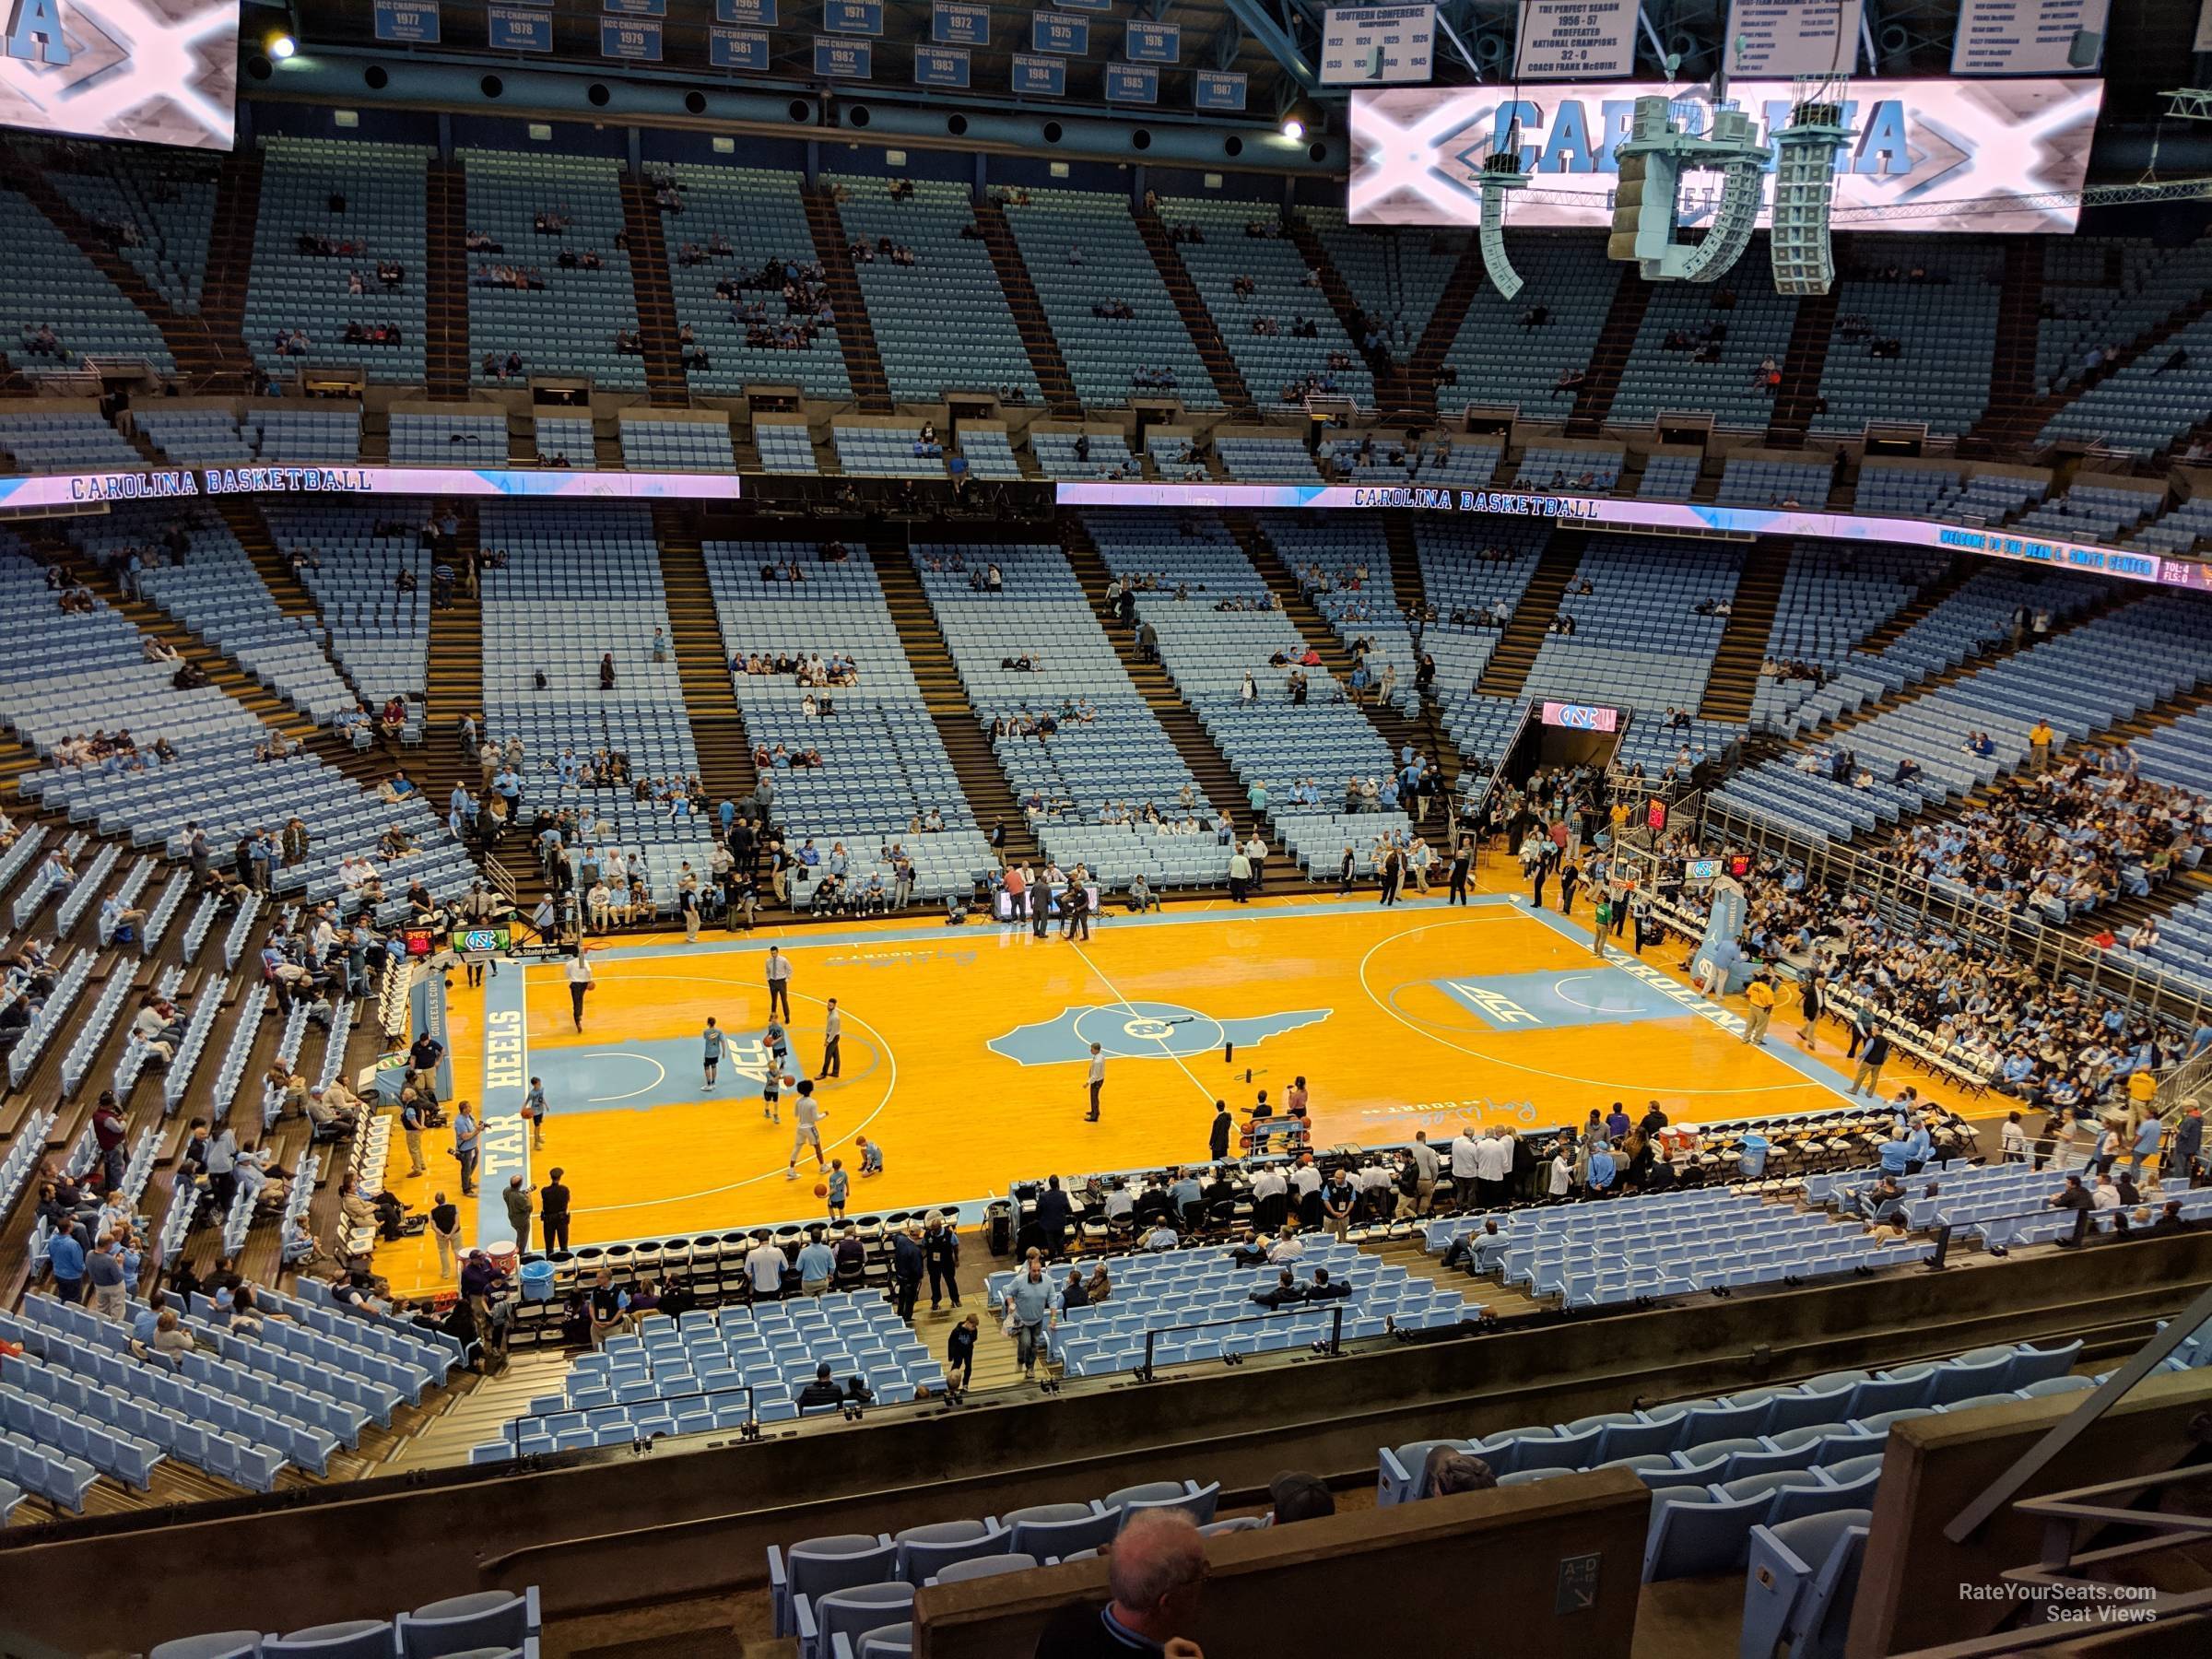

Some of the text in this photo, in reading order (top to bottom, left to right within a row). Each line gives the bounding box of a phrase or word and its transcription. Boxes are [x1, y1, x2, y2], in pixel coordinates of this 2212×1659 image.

[1335, 7, 1425, 21] SOUTHERN CONFERENCE
[1554, 5, 1587, 13] PERFECT
[1533, 38, 1618, 48] NATIONAL CHAMPIONS
[1552, 28, 1600, 37] UNDEFEATED
[1528, 63, 1554, 72] COACH
[1556, 63, 1581, 71] FRANK
[70, 467, 372, 500] CAROLINA BASKETBALL
[1354, 488, 1599, 519] CAROLINA BASKETBALL
[1940, 530, 1985, 548] WELCOME
[2005, 539, 2022, 555] THE
[2025, 542, 2052, 559] DEAN
[2069, 549, 2104, 568] SMITH
[2108, 555, 2151, 575] CENTER
[1447, 981, 1543, 1024] ACC
[487, 1010, 523, 1088] HEELS
[1387, 1101, 1457, 1113] COURT
[485, 1112, 524, 1175] TAR
